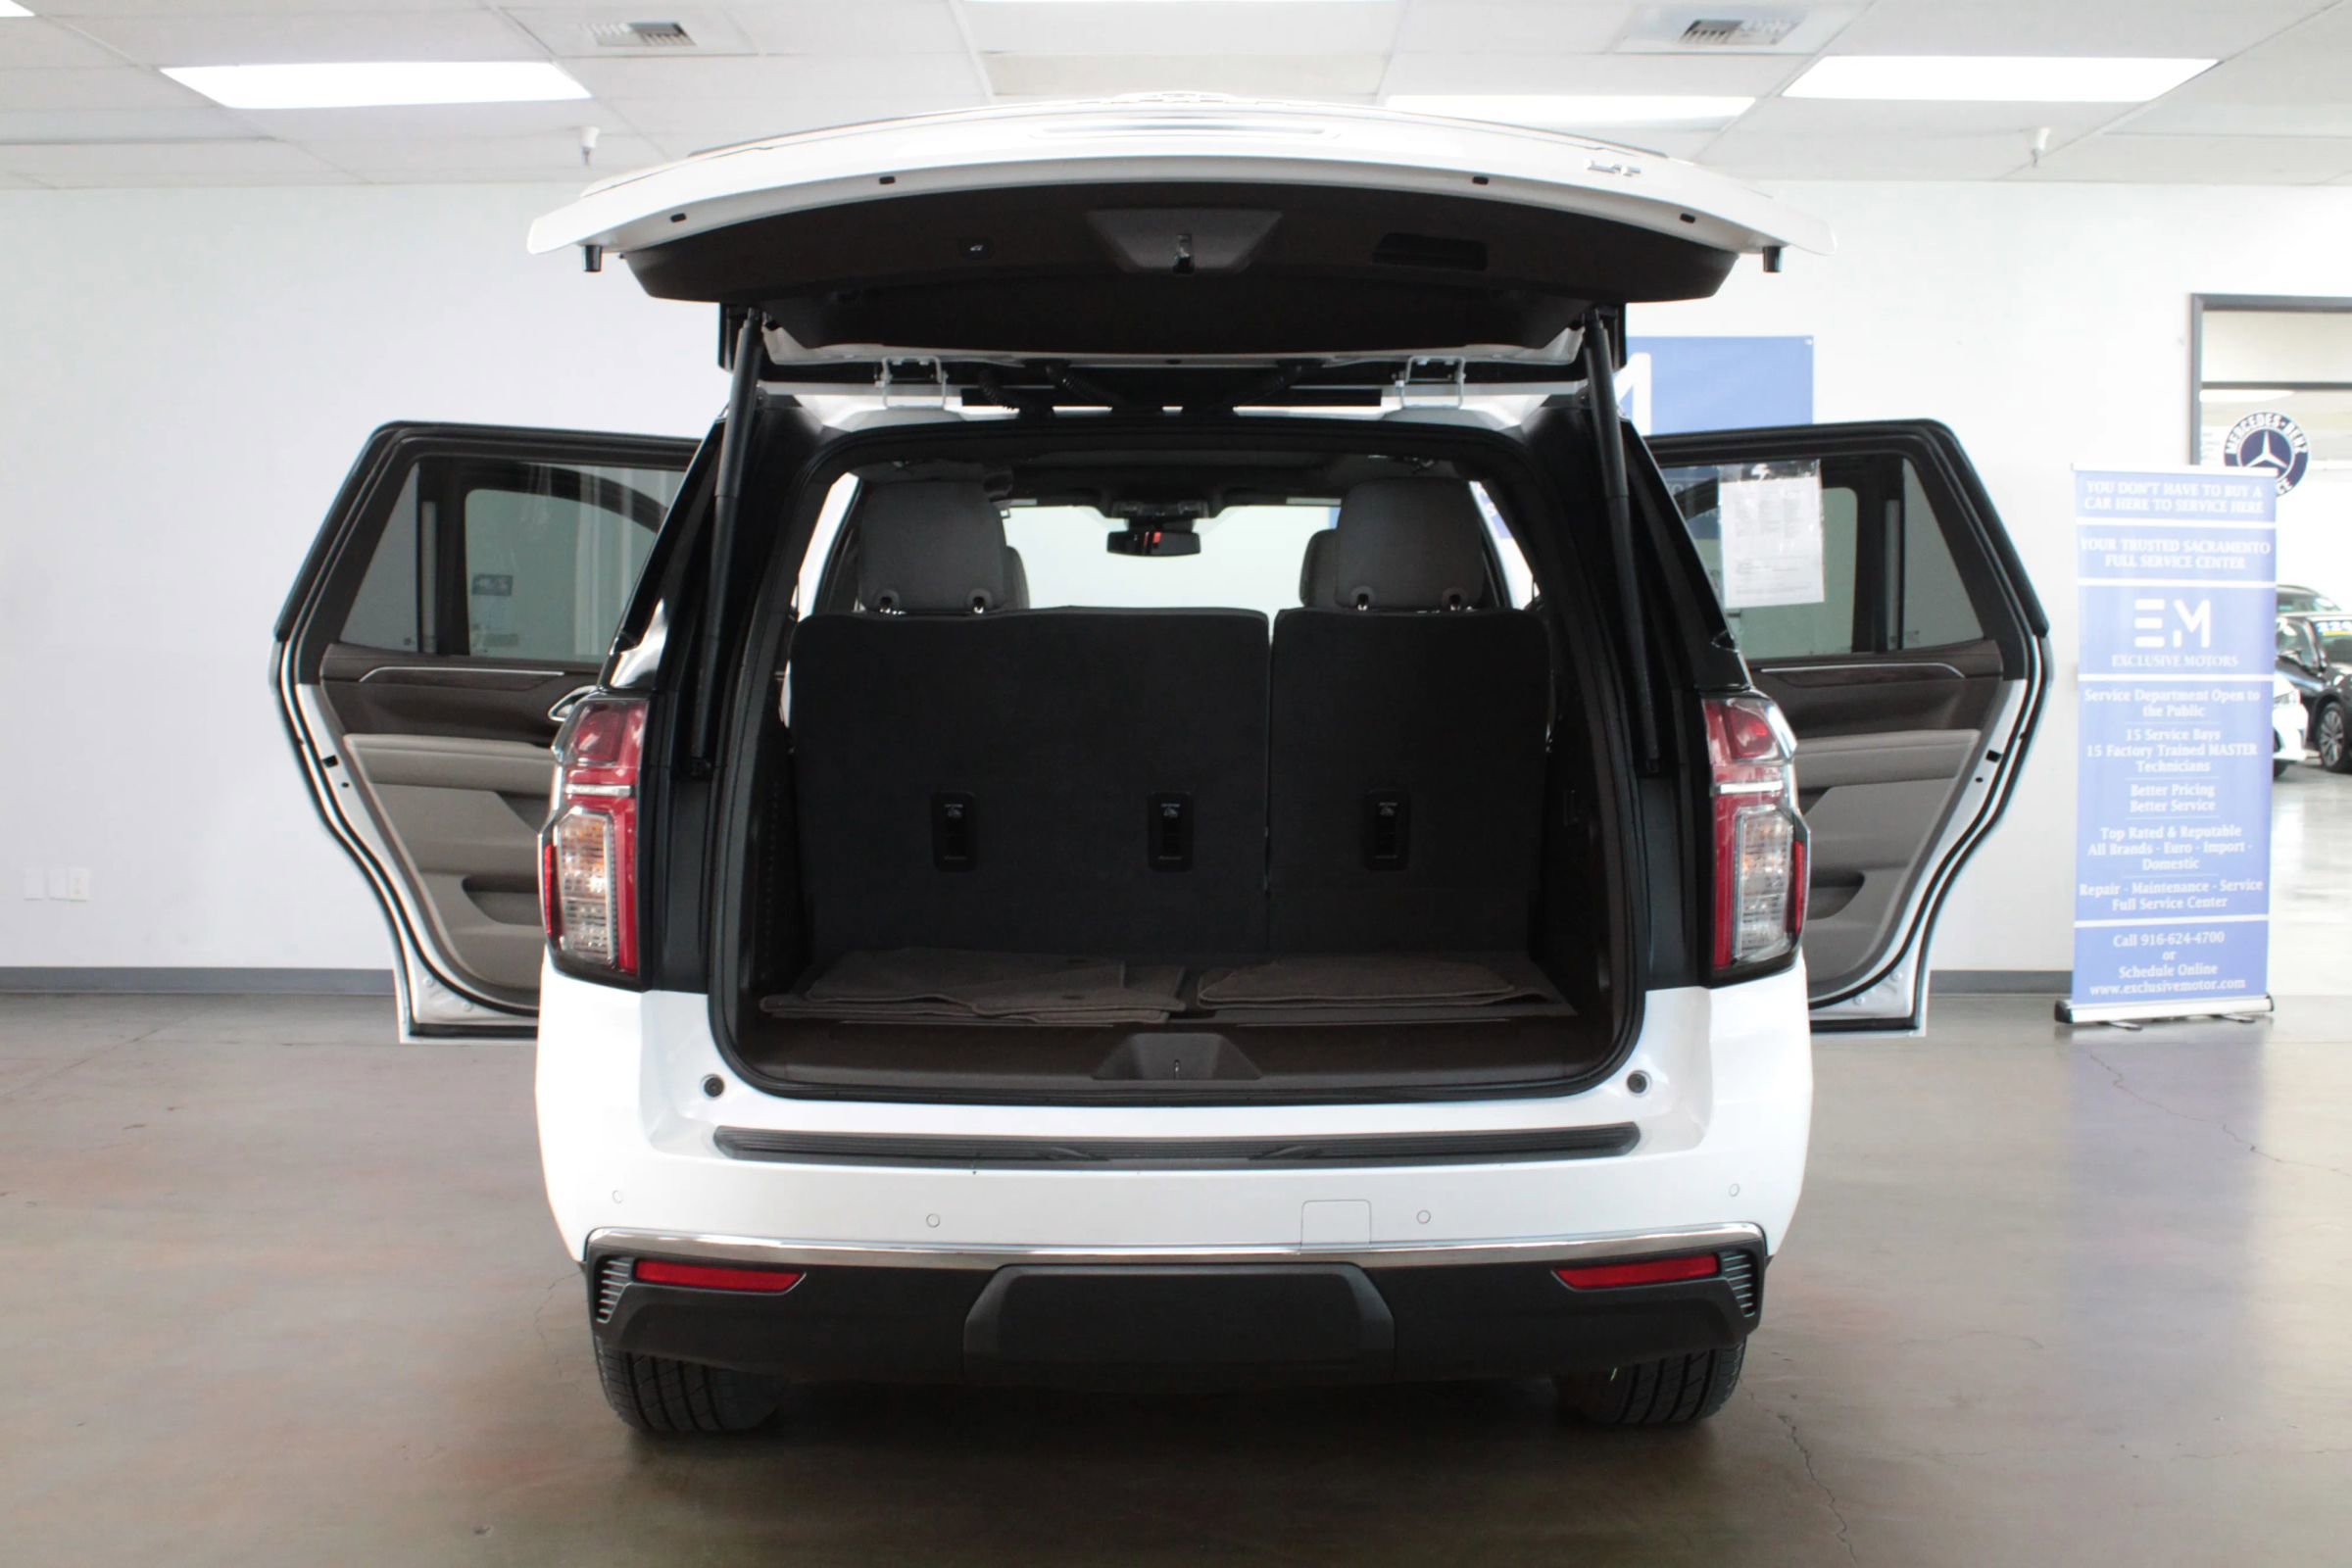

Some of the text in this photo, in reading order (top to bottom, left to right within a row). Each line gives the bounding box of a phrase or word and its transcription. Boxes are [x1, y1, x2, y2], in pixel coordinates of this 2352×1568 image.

[2086, 480, 2114, 494] YOU
[2118, 481, 2161, 494] DON'T
[2164, 482, 2200, 496] HAVE
[2202, 483, 2222, 497] TO
[2225, 484, 2252, 497] BUY
[2253, 485, 2263, 498] A
[2084, 497, 2264, 513] CAR HERE TO SERVICE HERE
[2080, 538, 2271, 554] YOUR TRUSTED SACRAMENTO
[2105, 554, 2245, 569] FULL SERVICE CENTER
[2134, 599, 2211, 648] EM
[2112, 655, 2238, 667] EXCLUSIVE MOTORS
[2084, 689, 2260, 705] Service Department Open to
[2142, 705, 2206, 716] the Public
[2126, 728, 2222, 742] 15 Service Bays
[2086, 743, 2258, 759] 15 Factory Trained MASTER
[2135, 760, 2211, 772] Technicians
[2131, 783, 2215, 798] Better Pricing
[2130, 799, 2215, 812] Better Service
[2100, 824, 2242, 842] Top Rated & Reputable
[2087, 843, 2106, 856] All
[2110, 842, 2153, 855] Brands
[2164, 841, 2192, 854] Euro
[2203, 841, 2245, 855] Import
[2142, 858, 2199, 870] Domestic
[2080, 883, 2121, 898] Repair
[2132, 882, 2210, 894] Maintenance
[2220, 879, 2264, 892] Service
[2112, 896, 2228, 911] Full Service Center
[2113, 931, 2226, 948] Call 916-624-4700
[2162, 951, 2177, 961] or
[2119, 962, 2219, 978] Schedule Online
[2089, 979, 2246, 997] www.exclusivemotor.com
